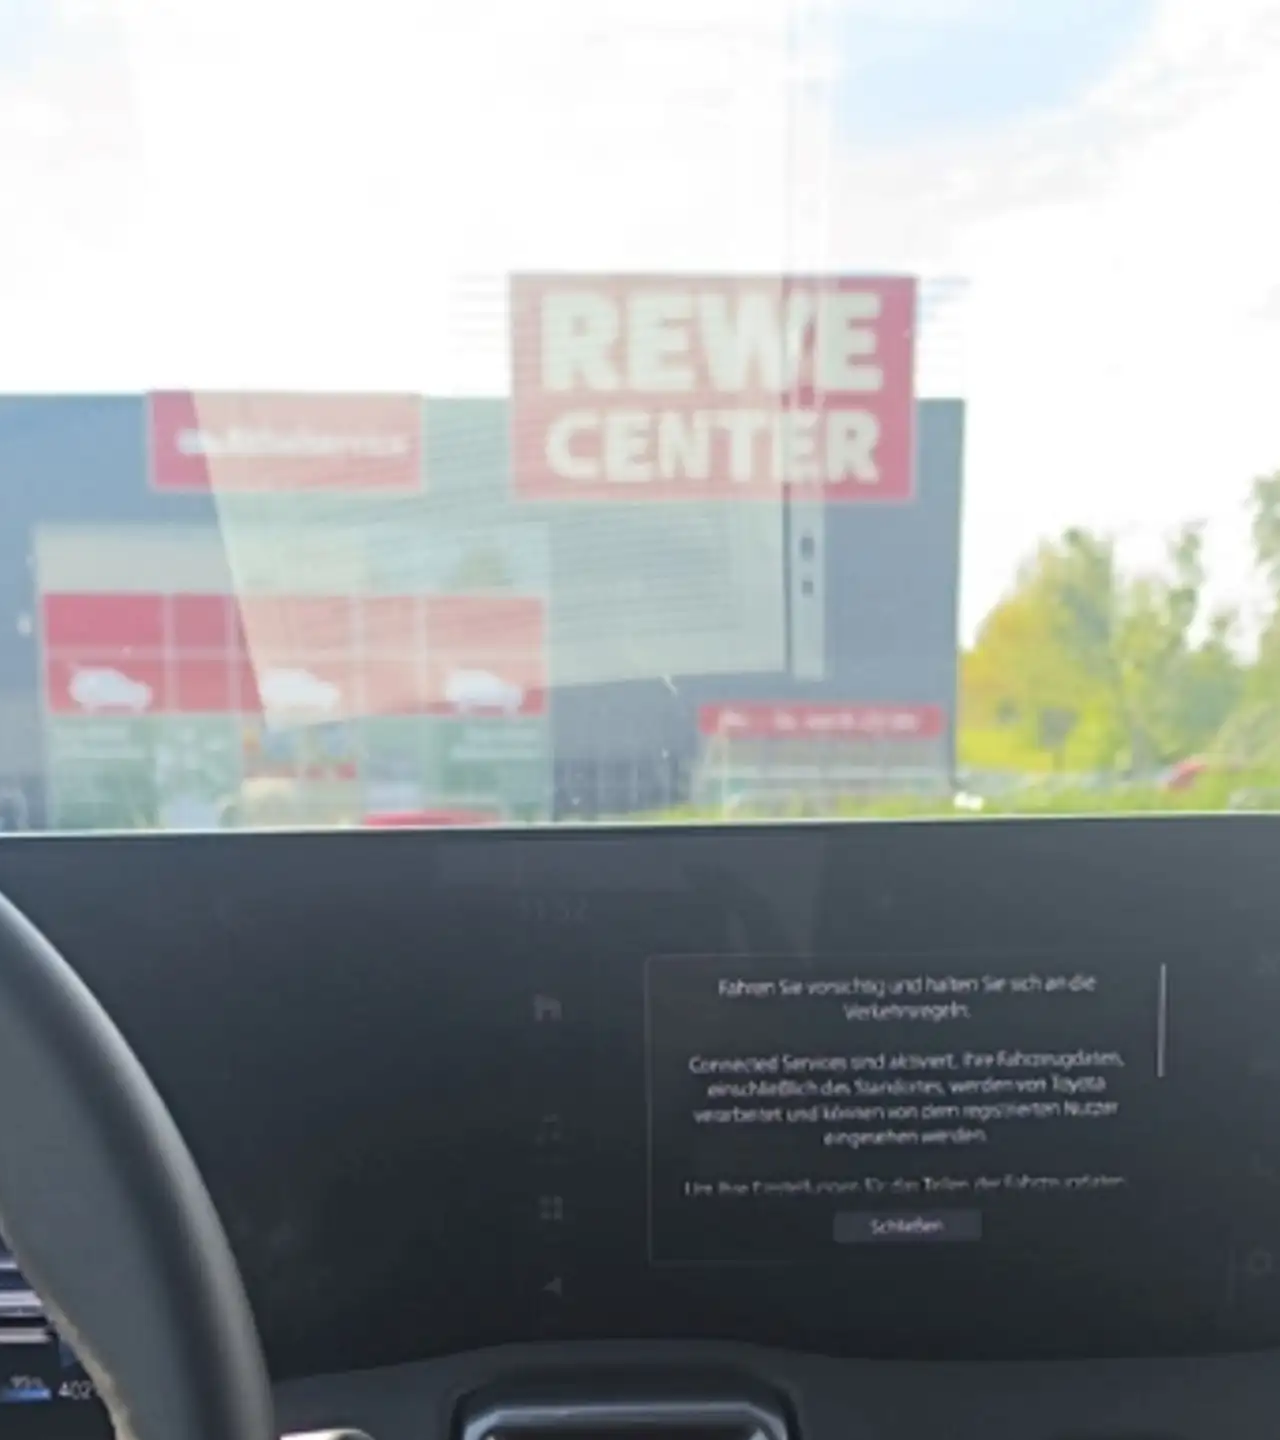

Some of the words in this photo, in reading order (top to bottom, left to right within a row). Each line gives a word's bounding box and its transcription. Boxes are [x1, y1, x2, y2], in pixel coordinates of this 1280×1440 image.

[540, 292, 883, 391] REWE
[544, 407, 880, 484] CENTER
[718, 977, 775, 997] Fahren
[778, 977, 804, 996] Sie
[806, 975, 886, 998] vorsichtig
[888, 975, 923, 995] und
[925, 974, 978, 993] halten
[981, 974, 1007, 992] Sie
[1010, 972, 1043, 992] sich
[1045, 977, 1066, 992] an
[1068, 973, 1098, 992] die
[687, 1055, 780, 1074] Connected
[782, 1054, 848, 1072] Services
[850, 1053, 885, 1071] sind
[706, 1079, 819, 1098] einschließlich
[820, 1078, 852, 1096] des
[948, 1076, 1014, 1094] werden
[1015, 1077, 1048, 1093] von
[1050, 1073, 1107, 1094] Toyota
[692, 1105, 784, 1124] verarbeitet
[785, 1105, 819, 1123] und
[821, 1103, 885, 1121] können
[886, 1105, 919, 1121] von
[920, 1103, 961, 1121] dem
[962, 1102, 1062, 1122] registrierten
[1063, 1100, 1119, 1117] Nutzer
[822, 1129, 919, 1149] eingesehen
[869, 1216, 945, 1235] Schließen
